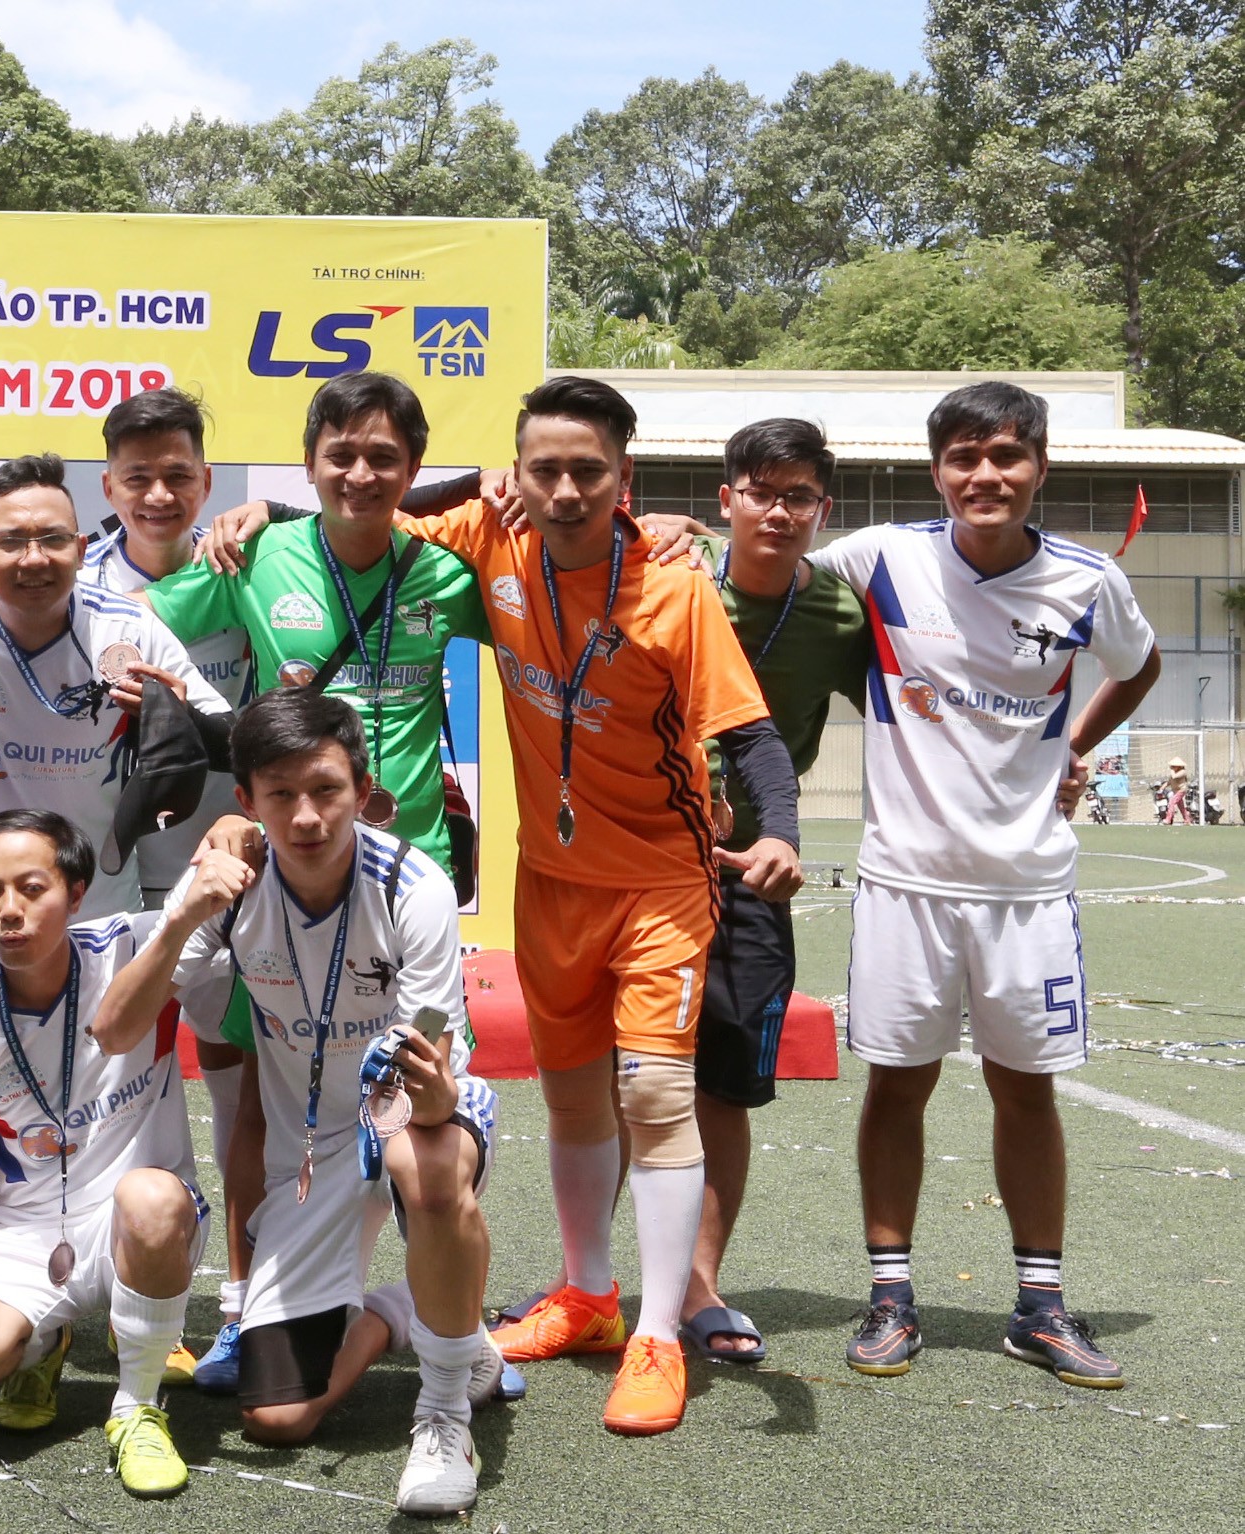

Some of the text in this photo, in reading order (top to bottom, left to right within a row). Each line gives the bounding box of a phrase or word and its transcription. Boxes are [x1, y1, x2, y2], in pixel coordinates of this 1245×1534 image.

[312, 265, 336, 279] TÀI
[340, 267, 370, 280] TRỢ
[48, 294, 107, 323] TP.
[121, 295, 205, 325] HCM
[249, 312, 373, 378] LS
[417, 352, 485, 377] TSN
[381, 665, 431, 686] PHUC
[945, 687, 1046, 718] QUI PHUC
[3, 741, 106, 765] QUI PHUC
[675, 966, 695, 1030] 1
[1044, 975, 1079, 1037] 5
[66, 1066, 154, 1129] QUI PHUC
